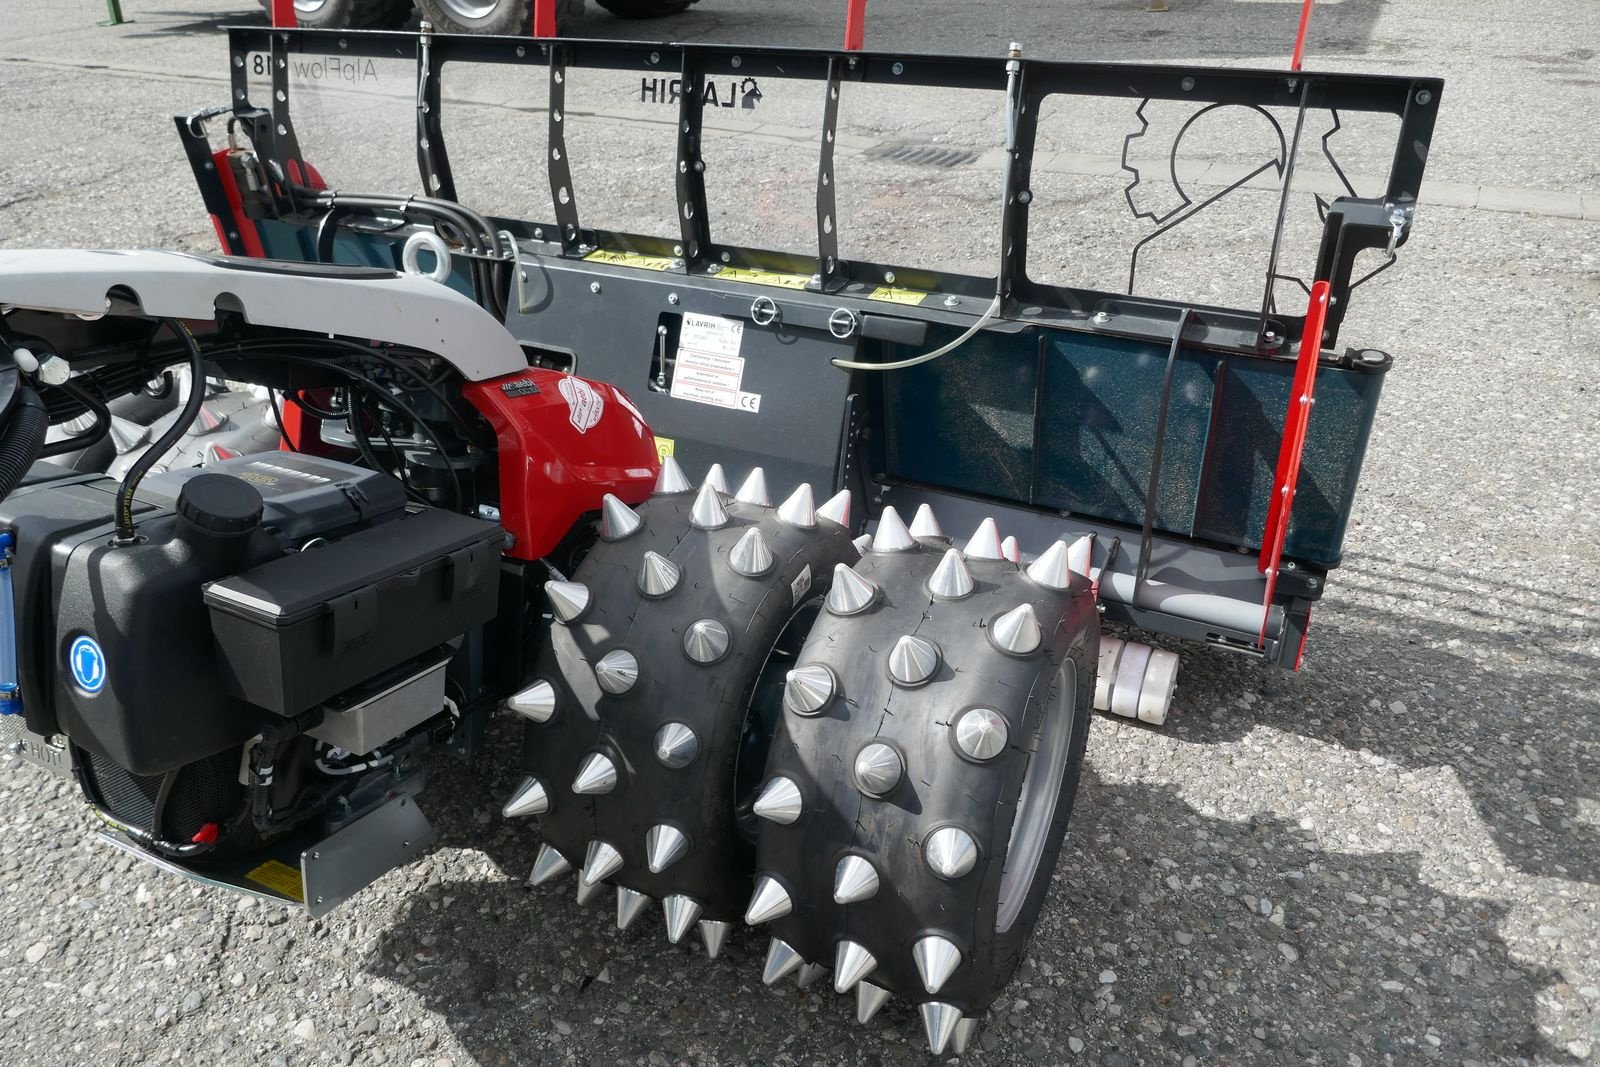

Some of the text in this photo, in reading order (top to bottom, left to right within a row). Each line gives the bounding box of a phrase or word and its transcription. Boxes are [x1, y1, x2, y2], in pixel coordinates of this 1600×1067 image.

[691, 319, 716, 329] LAVRIH
[741, 396, 757, 409] CE
[30, 741, 63, 769] HOT!
